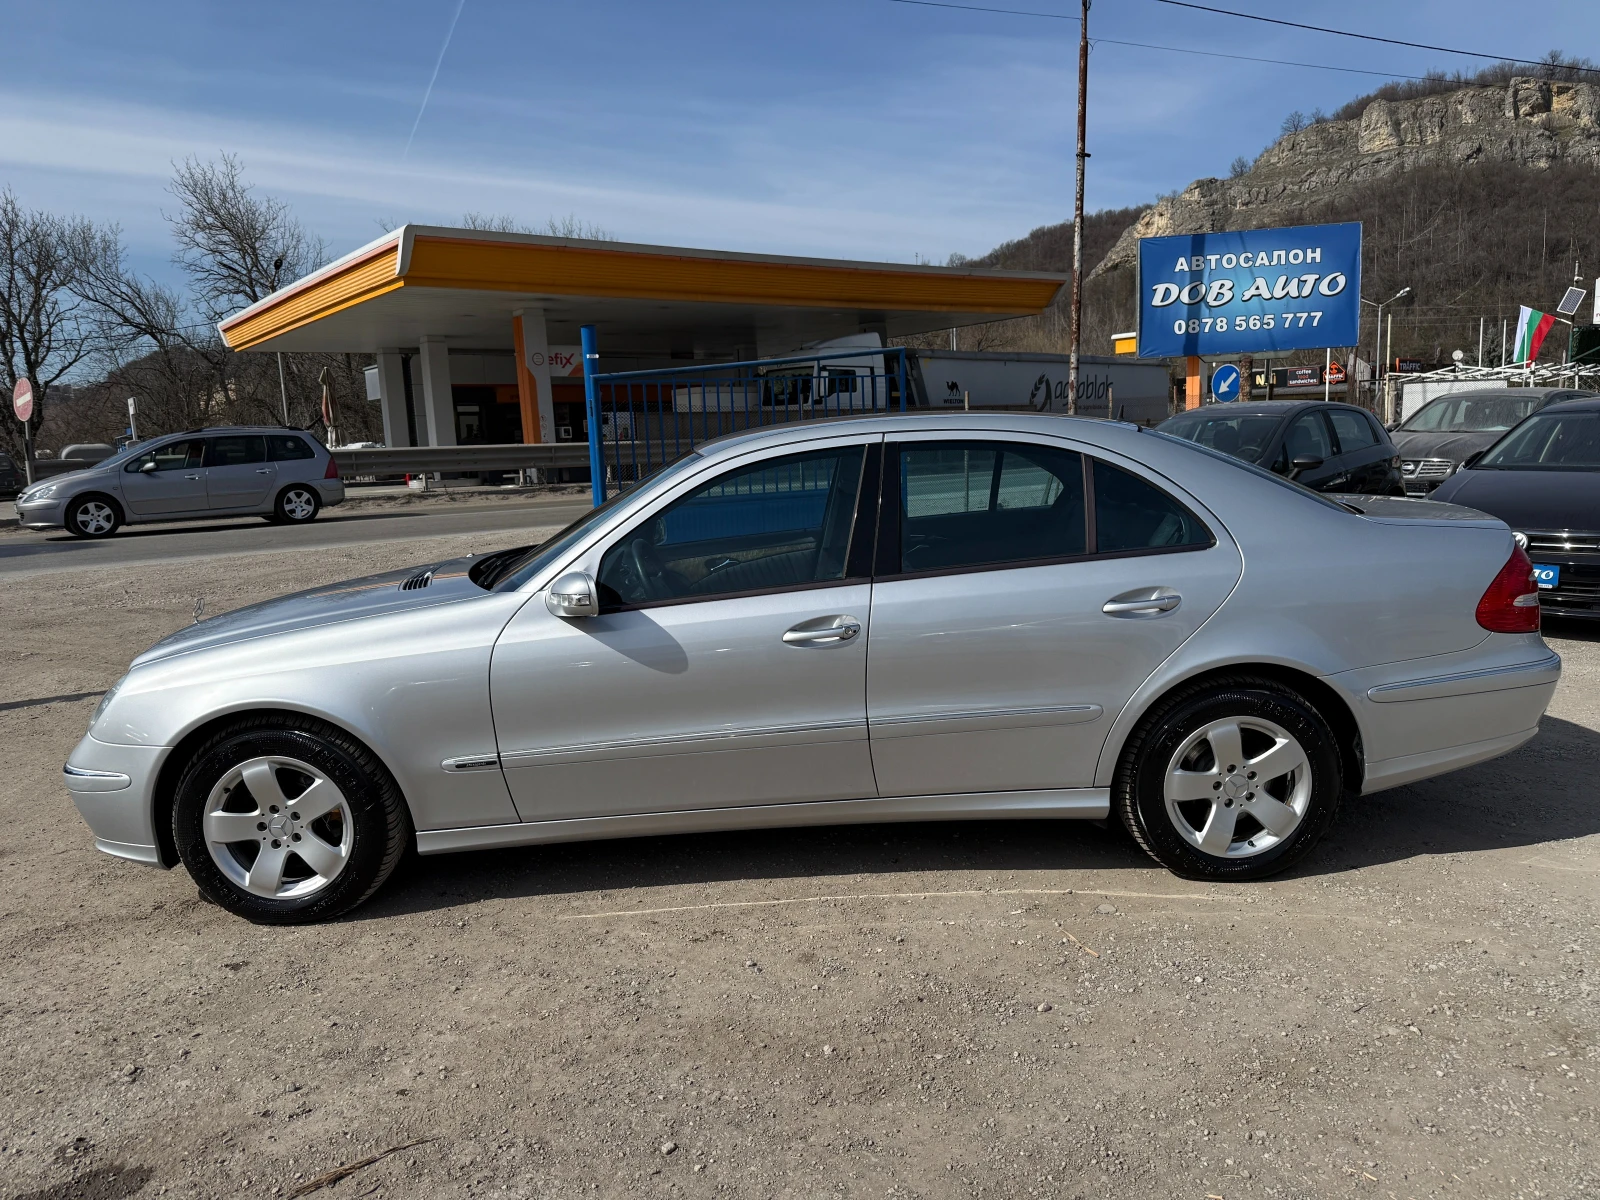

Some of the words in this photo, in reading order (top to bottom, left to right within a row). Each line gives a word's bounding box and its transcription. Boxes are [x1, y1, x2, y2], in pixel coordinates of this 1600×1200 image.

[1174, 247, 1322, 272] АВТОСАЛОН
[1151, 279, 1234, 307] DOB
[1241, 272, 1347, 301] AUTO
[1173, 317, 1228, 335] 0878
[1234, 314, 1275, 332] 565
[1281, 311, 1323, 328] 777
[1400, 361, 1420, 370] TRAFFIC
[1054, 374, 1114, 407] agoblok
